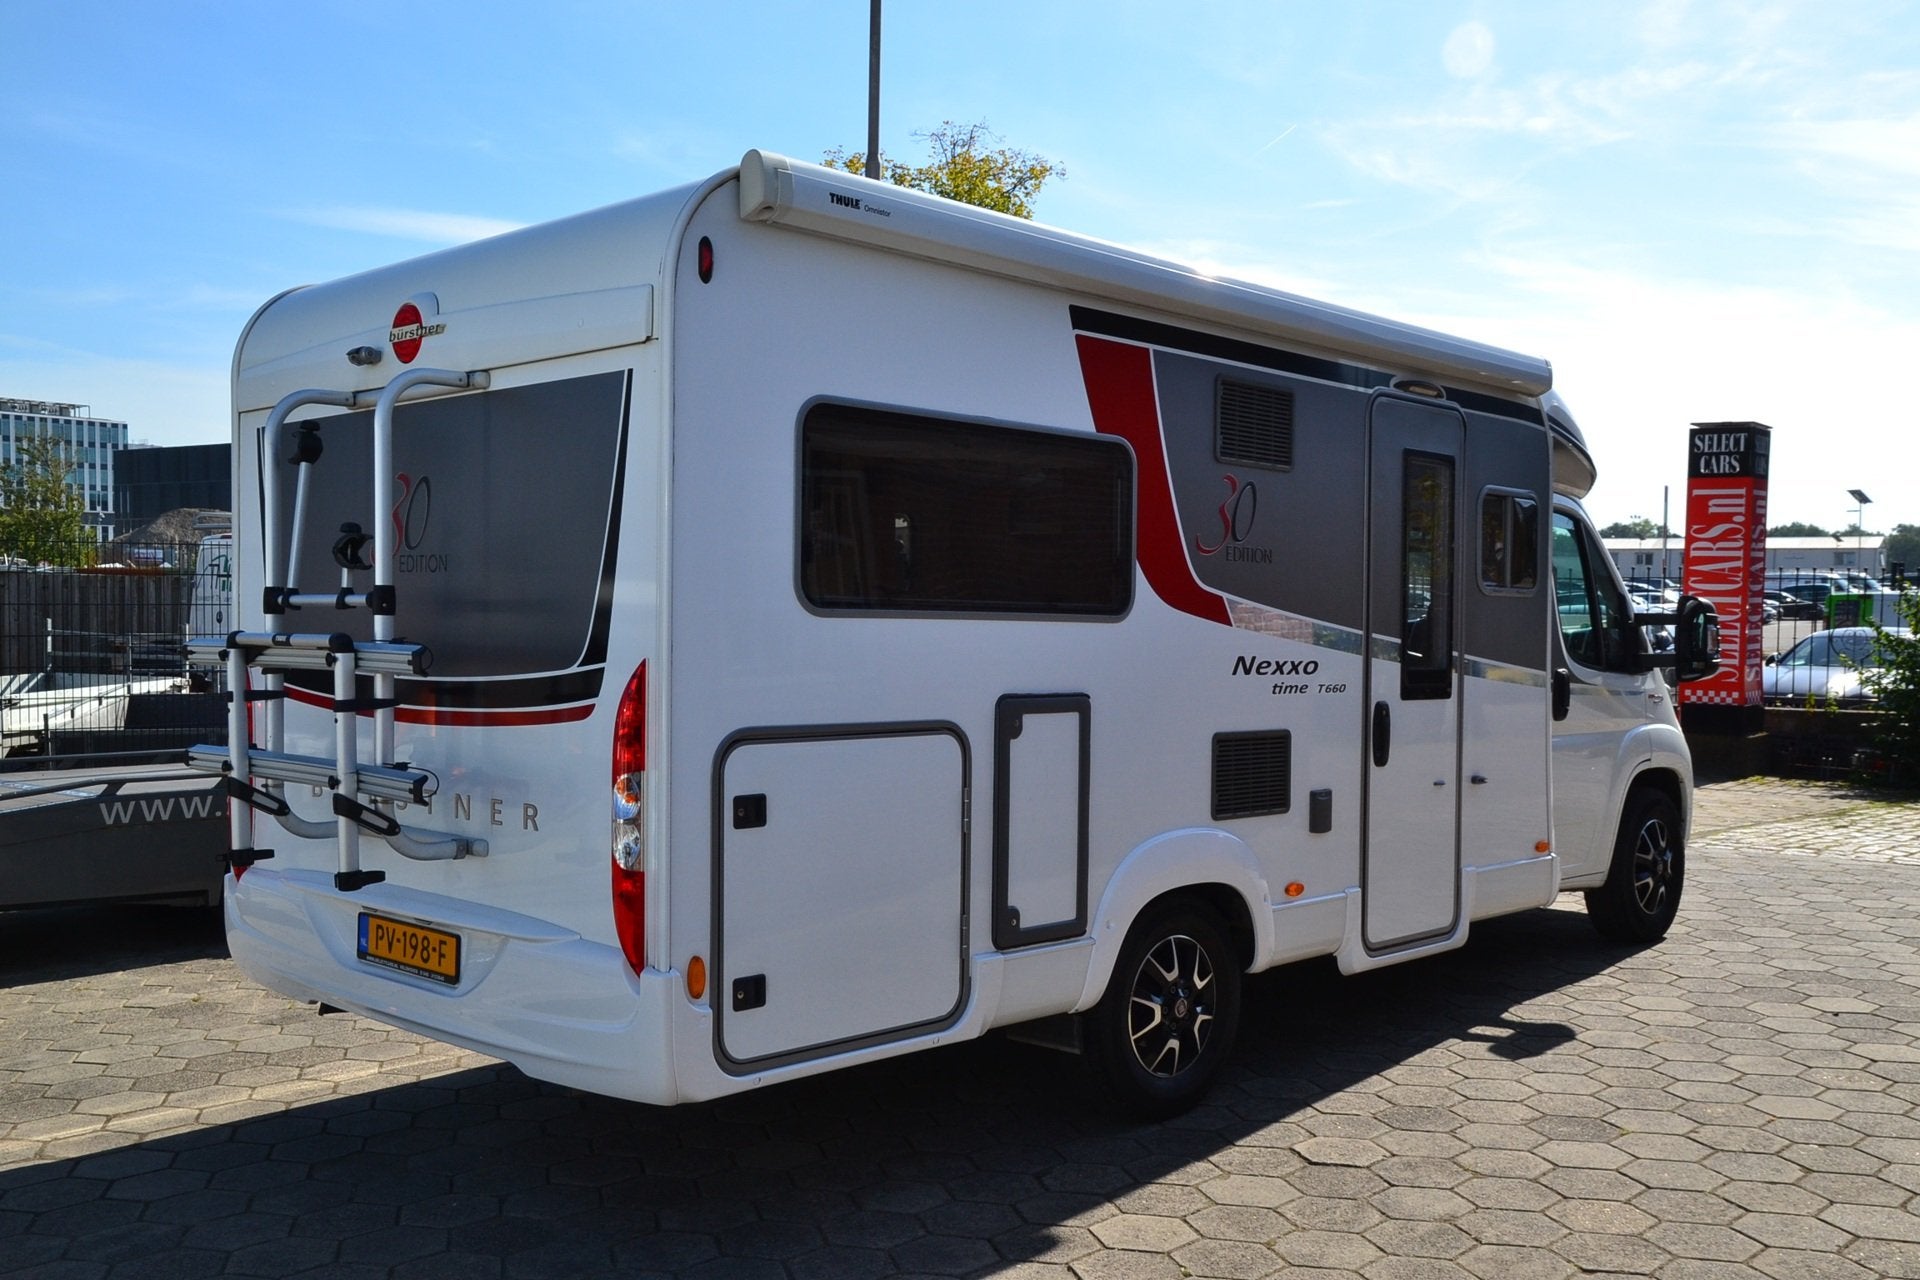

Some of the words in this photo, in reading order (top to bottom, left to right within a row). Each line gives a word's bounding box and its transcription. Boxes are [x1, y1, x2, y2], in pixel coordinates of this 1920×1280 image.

[829, 192, 860, 210] THULE
[864, 205, 891, 217] Omnistor
[388, 323, 442, 342] bürstner
[1694, 433, 1748, 453] SELECT
[1700, 455, 1740, 474] CARS
[1196, 473, 1257, 556] 30
[398, 554, 448, 573] EDITION
[1225, 546, 1273, 564] EDITION
[1232, 656, 1319, 676] Nexxo
[1272, 682, 1309, 695] time
[1318, 683, 1347, 694] T660
[100, 796, 222, 825] www.
[375, 924, 447, 967] PV-198-F
